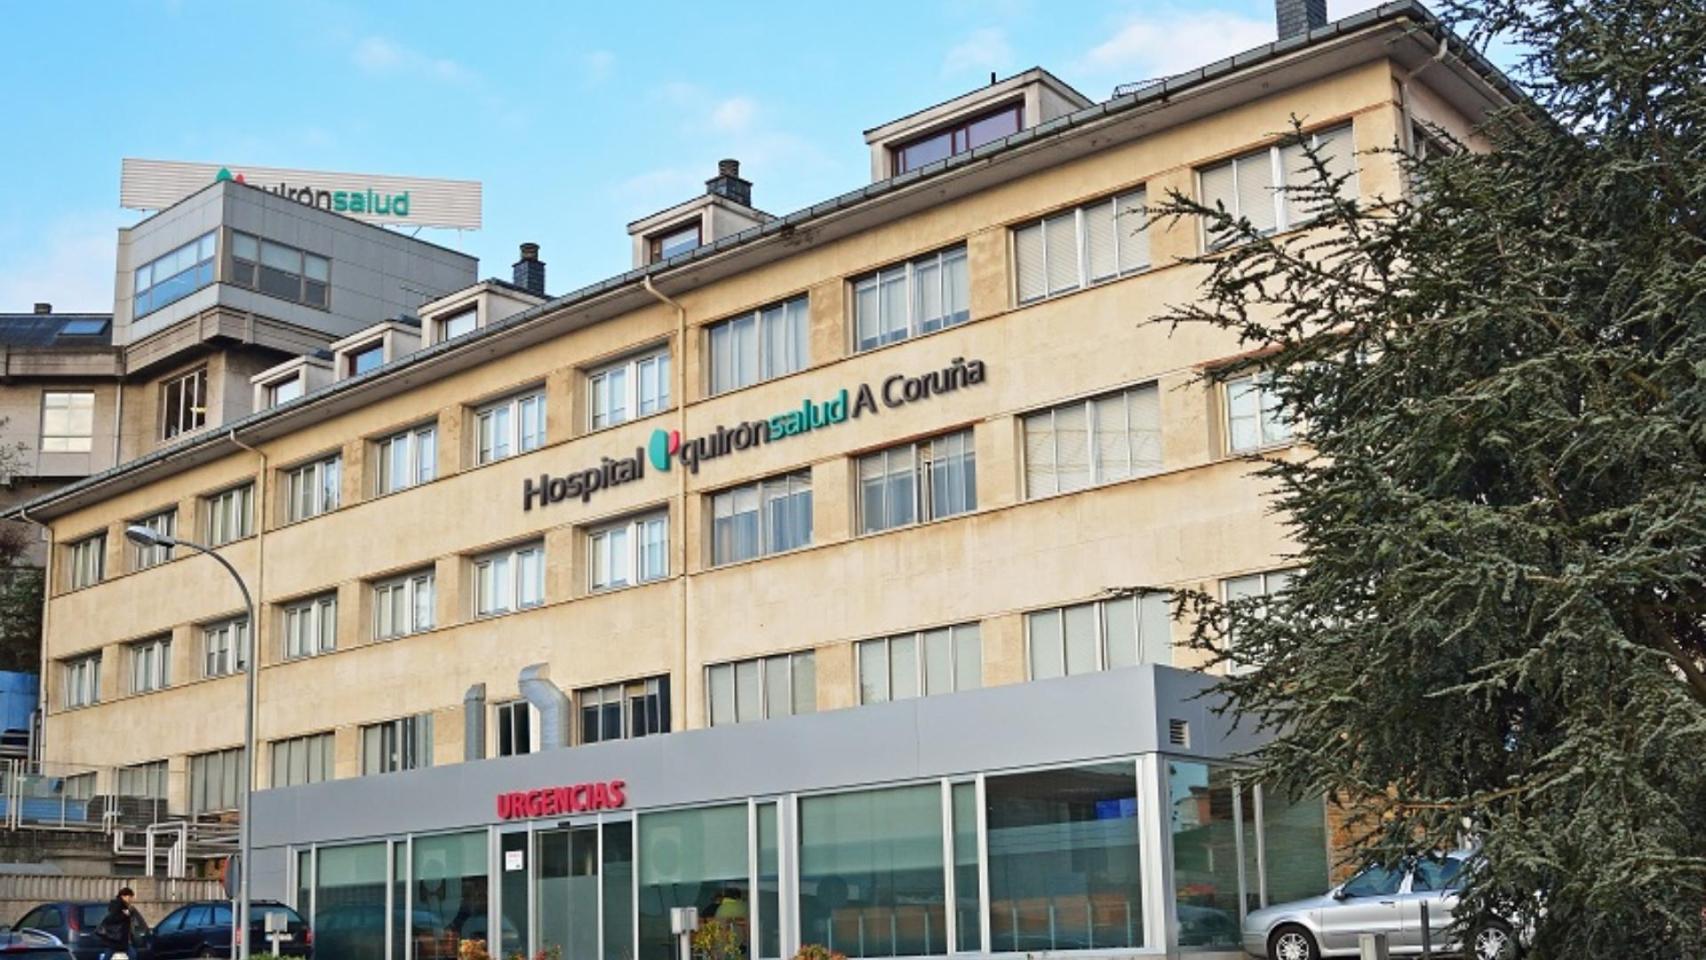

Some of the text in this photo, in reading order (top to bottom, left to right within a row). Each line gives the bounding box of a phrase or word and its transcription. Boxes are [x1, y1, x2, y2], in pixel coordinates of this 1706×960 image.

[254, 182, 410, 216] irónsalud
[523, 356, 986, 511] Hospital quirónsalud A Coruña
[497, 779, 626, 819] URGENCIAS
